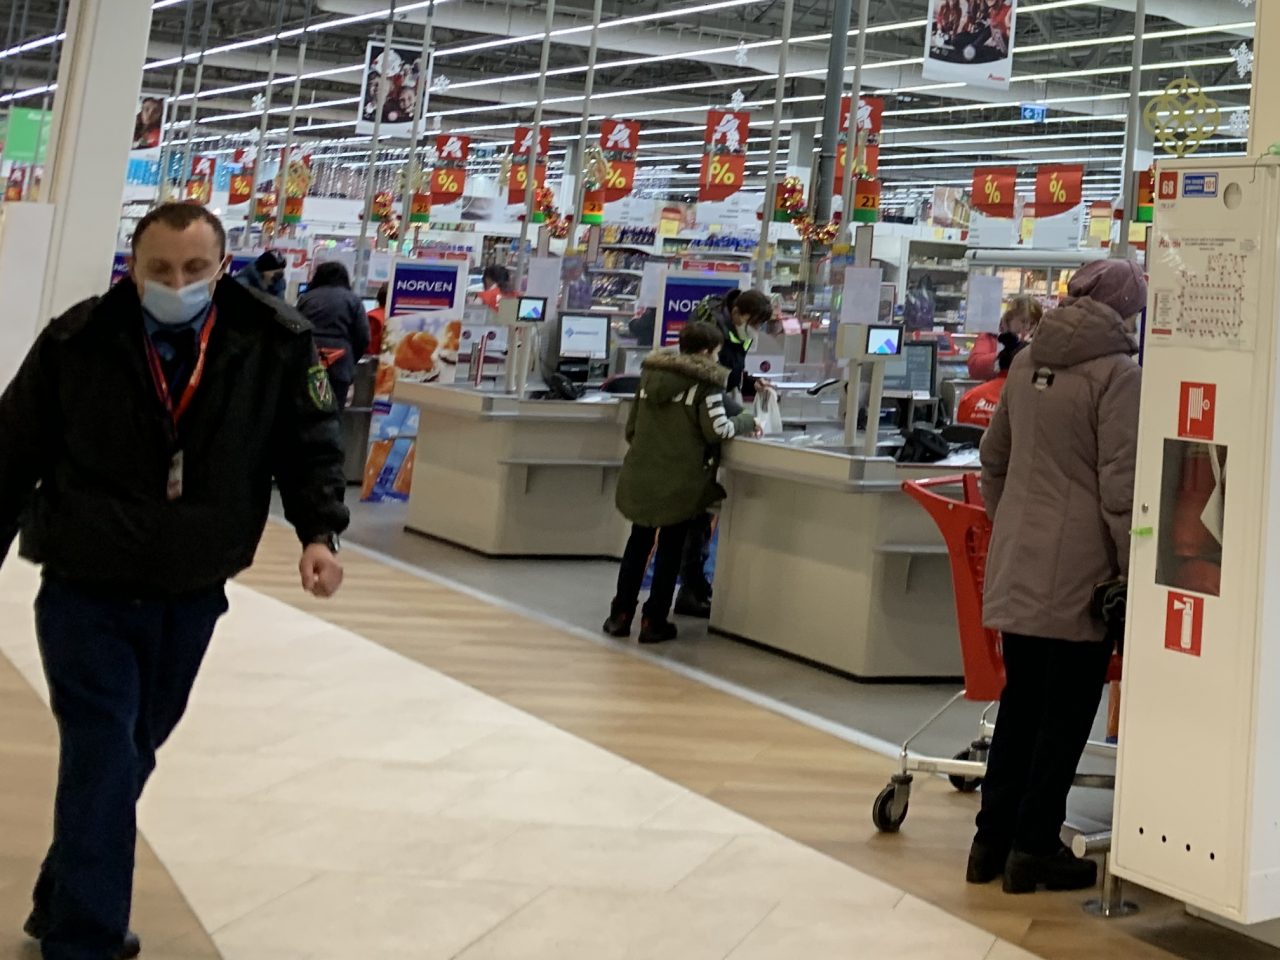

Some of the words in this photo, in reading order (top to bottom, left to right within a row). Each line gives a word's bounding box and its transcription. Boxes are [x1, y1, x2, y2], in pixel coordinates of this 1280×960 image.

[1162, 180, 1174, 194] 68
[861, 196, 877, 208] 21
[396, 279, 453, 293] NORVEN
